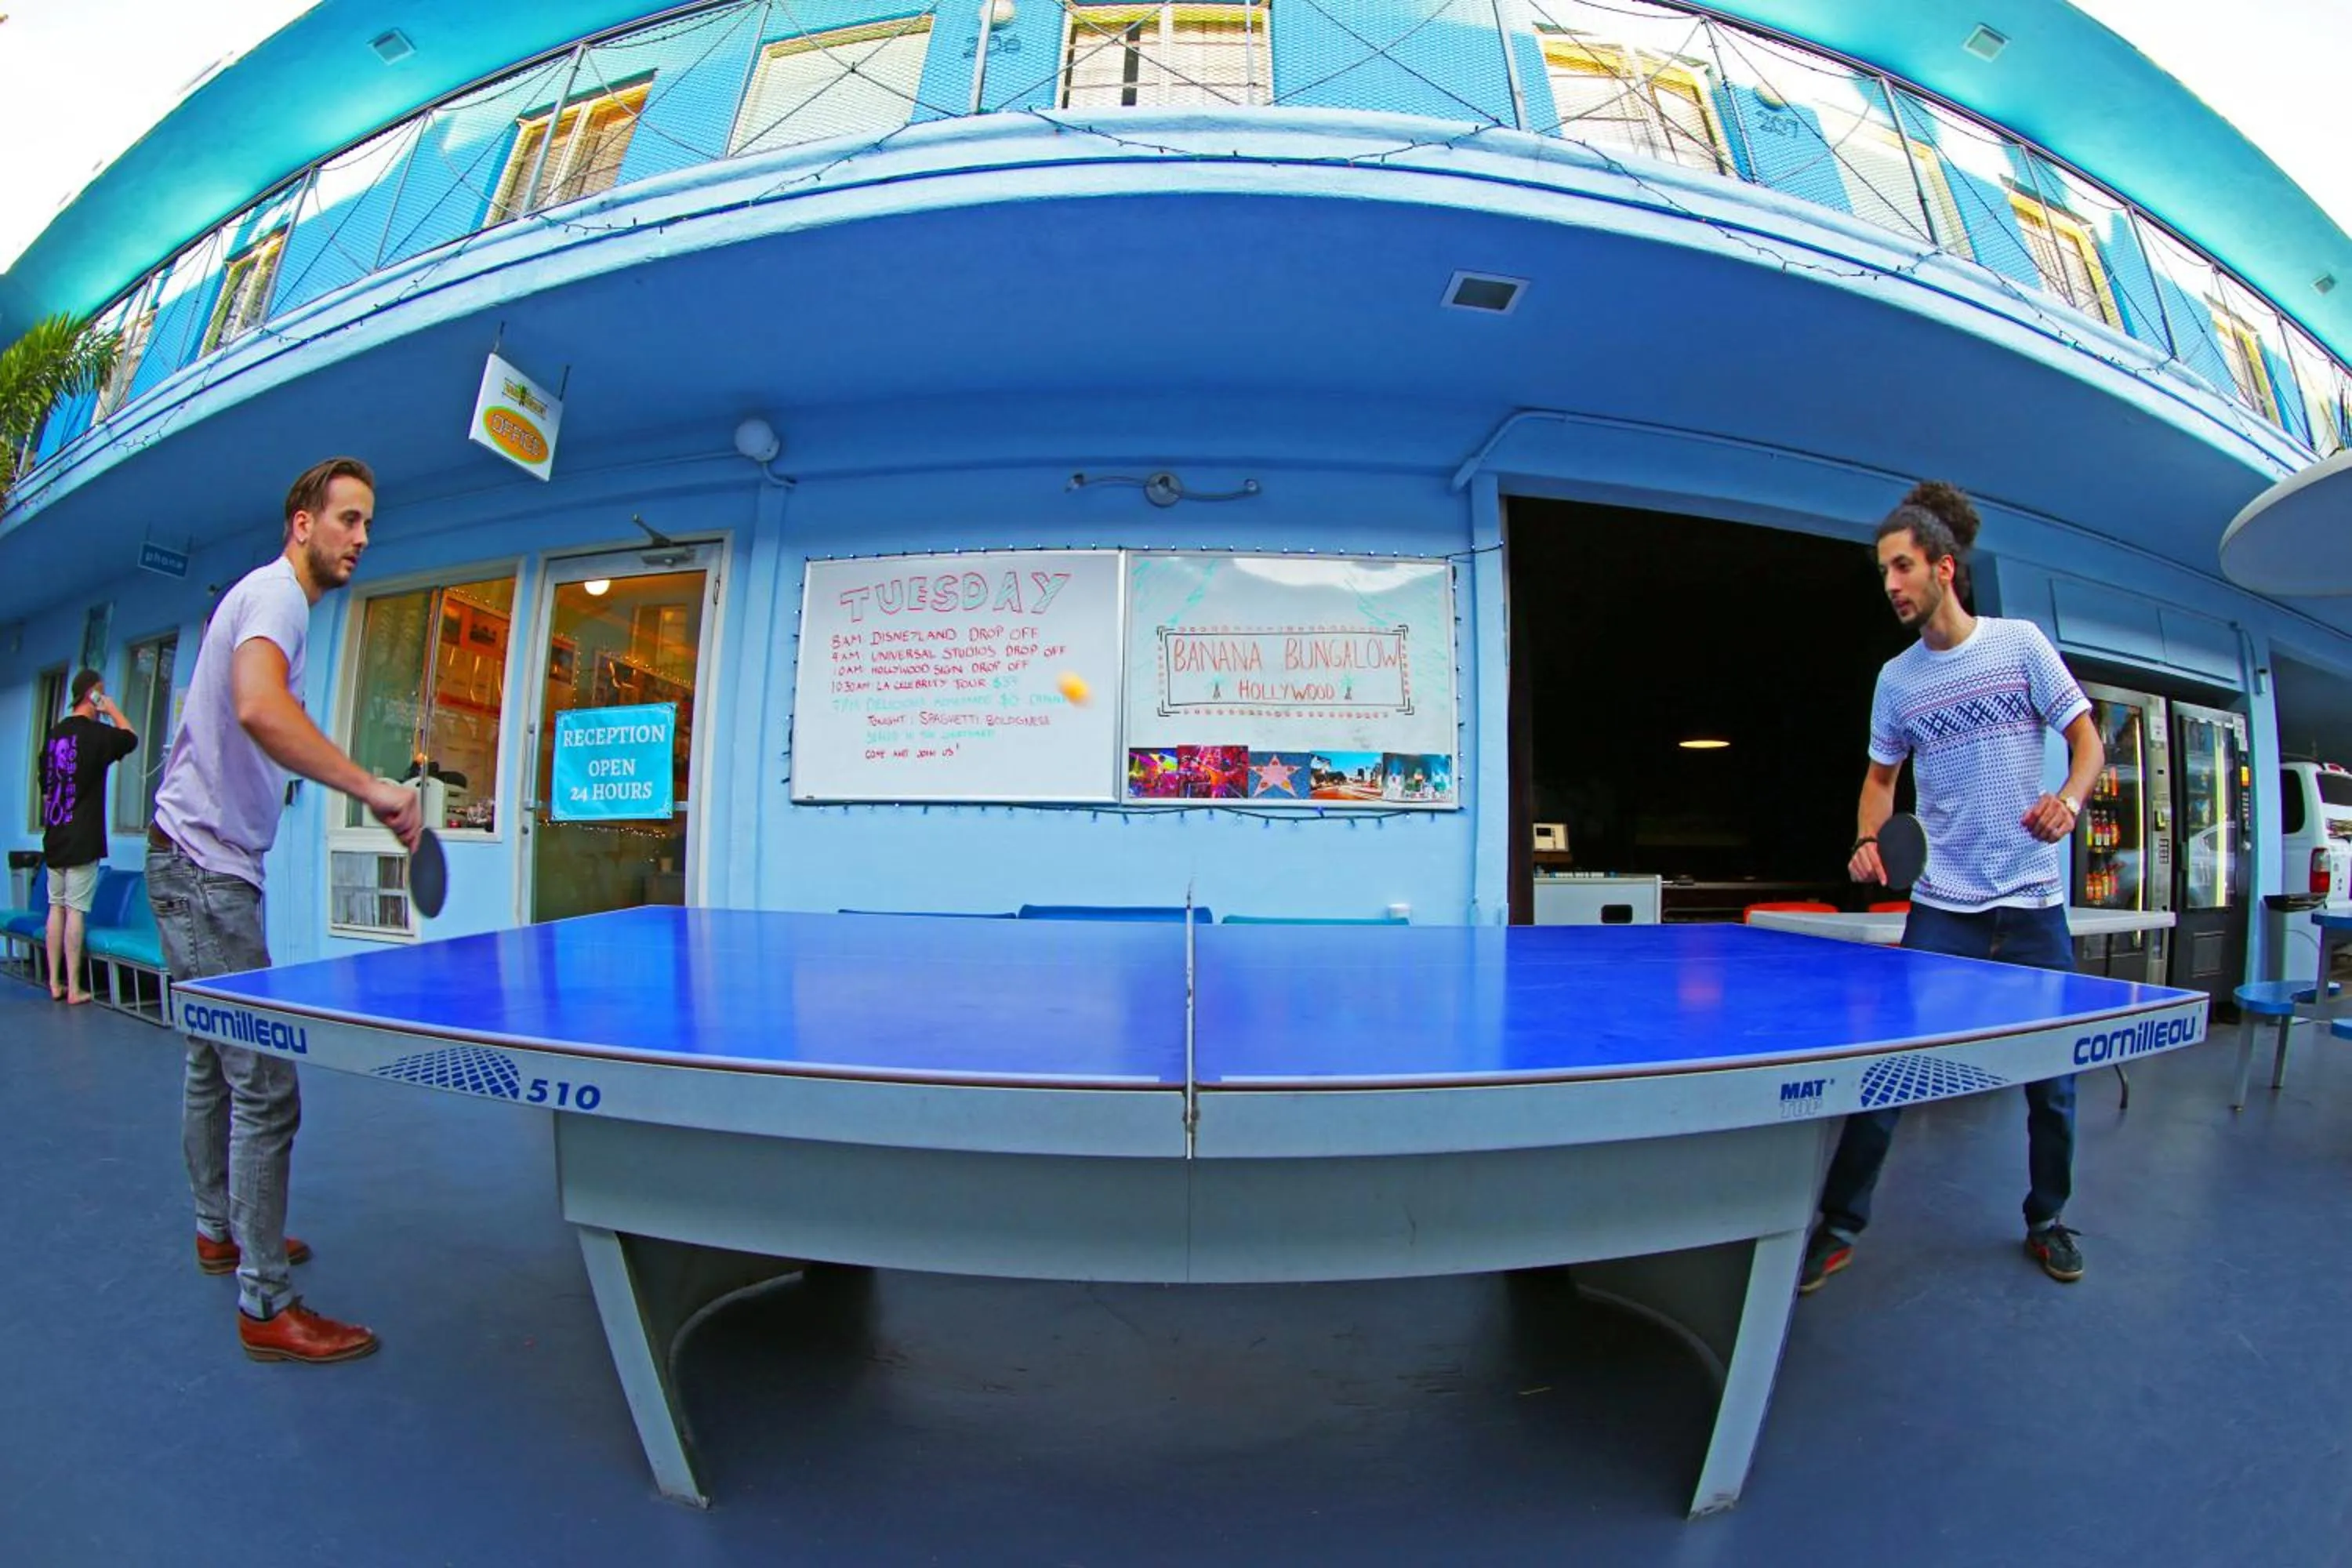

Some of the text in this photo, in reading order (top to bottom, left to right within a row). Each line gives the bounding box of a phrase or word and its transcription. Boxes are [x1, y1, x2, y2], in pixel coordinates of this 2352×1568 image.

[492, 413, 541, 456] OFFICE
[840, 572, 1072, 622] TUESDAY
[968, 624, 1004, 641] DROP
[1010, 626, 1039, 641] OFF
[871, 648, 936, 662] UNIVERSAL
[942, 644, 996, 660] STUDIOS
[1005, 644, 1039, 657] DROP
[1044, 645, 1066, 657] OFF
[1174, 637, 1401, 673] BANANA BUNGALOW
[871, 663, 930, 675] HOLLYWOOD
[933, 665, 964, 675] SIGN
[971, 660, 1000, 673] DROP
[1007, 659, 1029, 672] OFF
[877, 681, 891, 691] LA
[955, 678, 987, 690] TOUR
[1238, 680, 1336, 701] HOLLYWOOD
[919, 711, 980, 725] SPAGHETTI
[564, 724, 666, 748] RECEPTION
[589, 758, 637, 777] OPEN
[570, 782, 653, 803] 24 HOURS
[525, 1078, 601, 1111] 510
[1780, 1079, 1827, 1102] MAT
